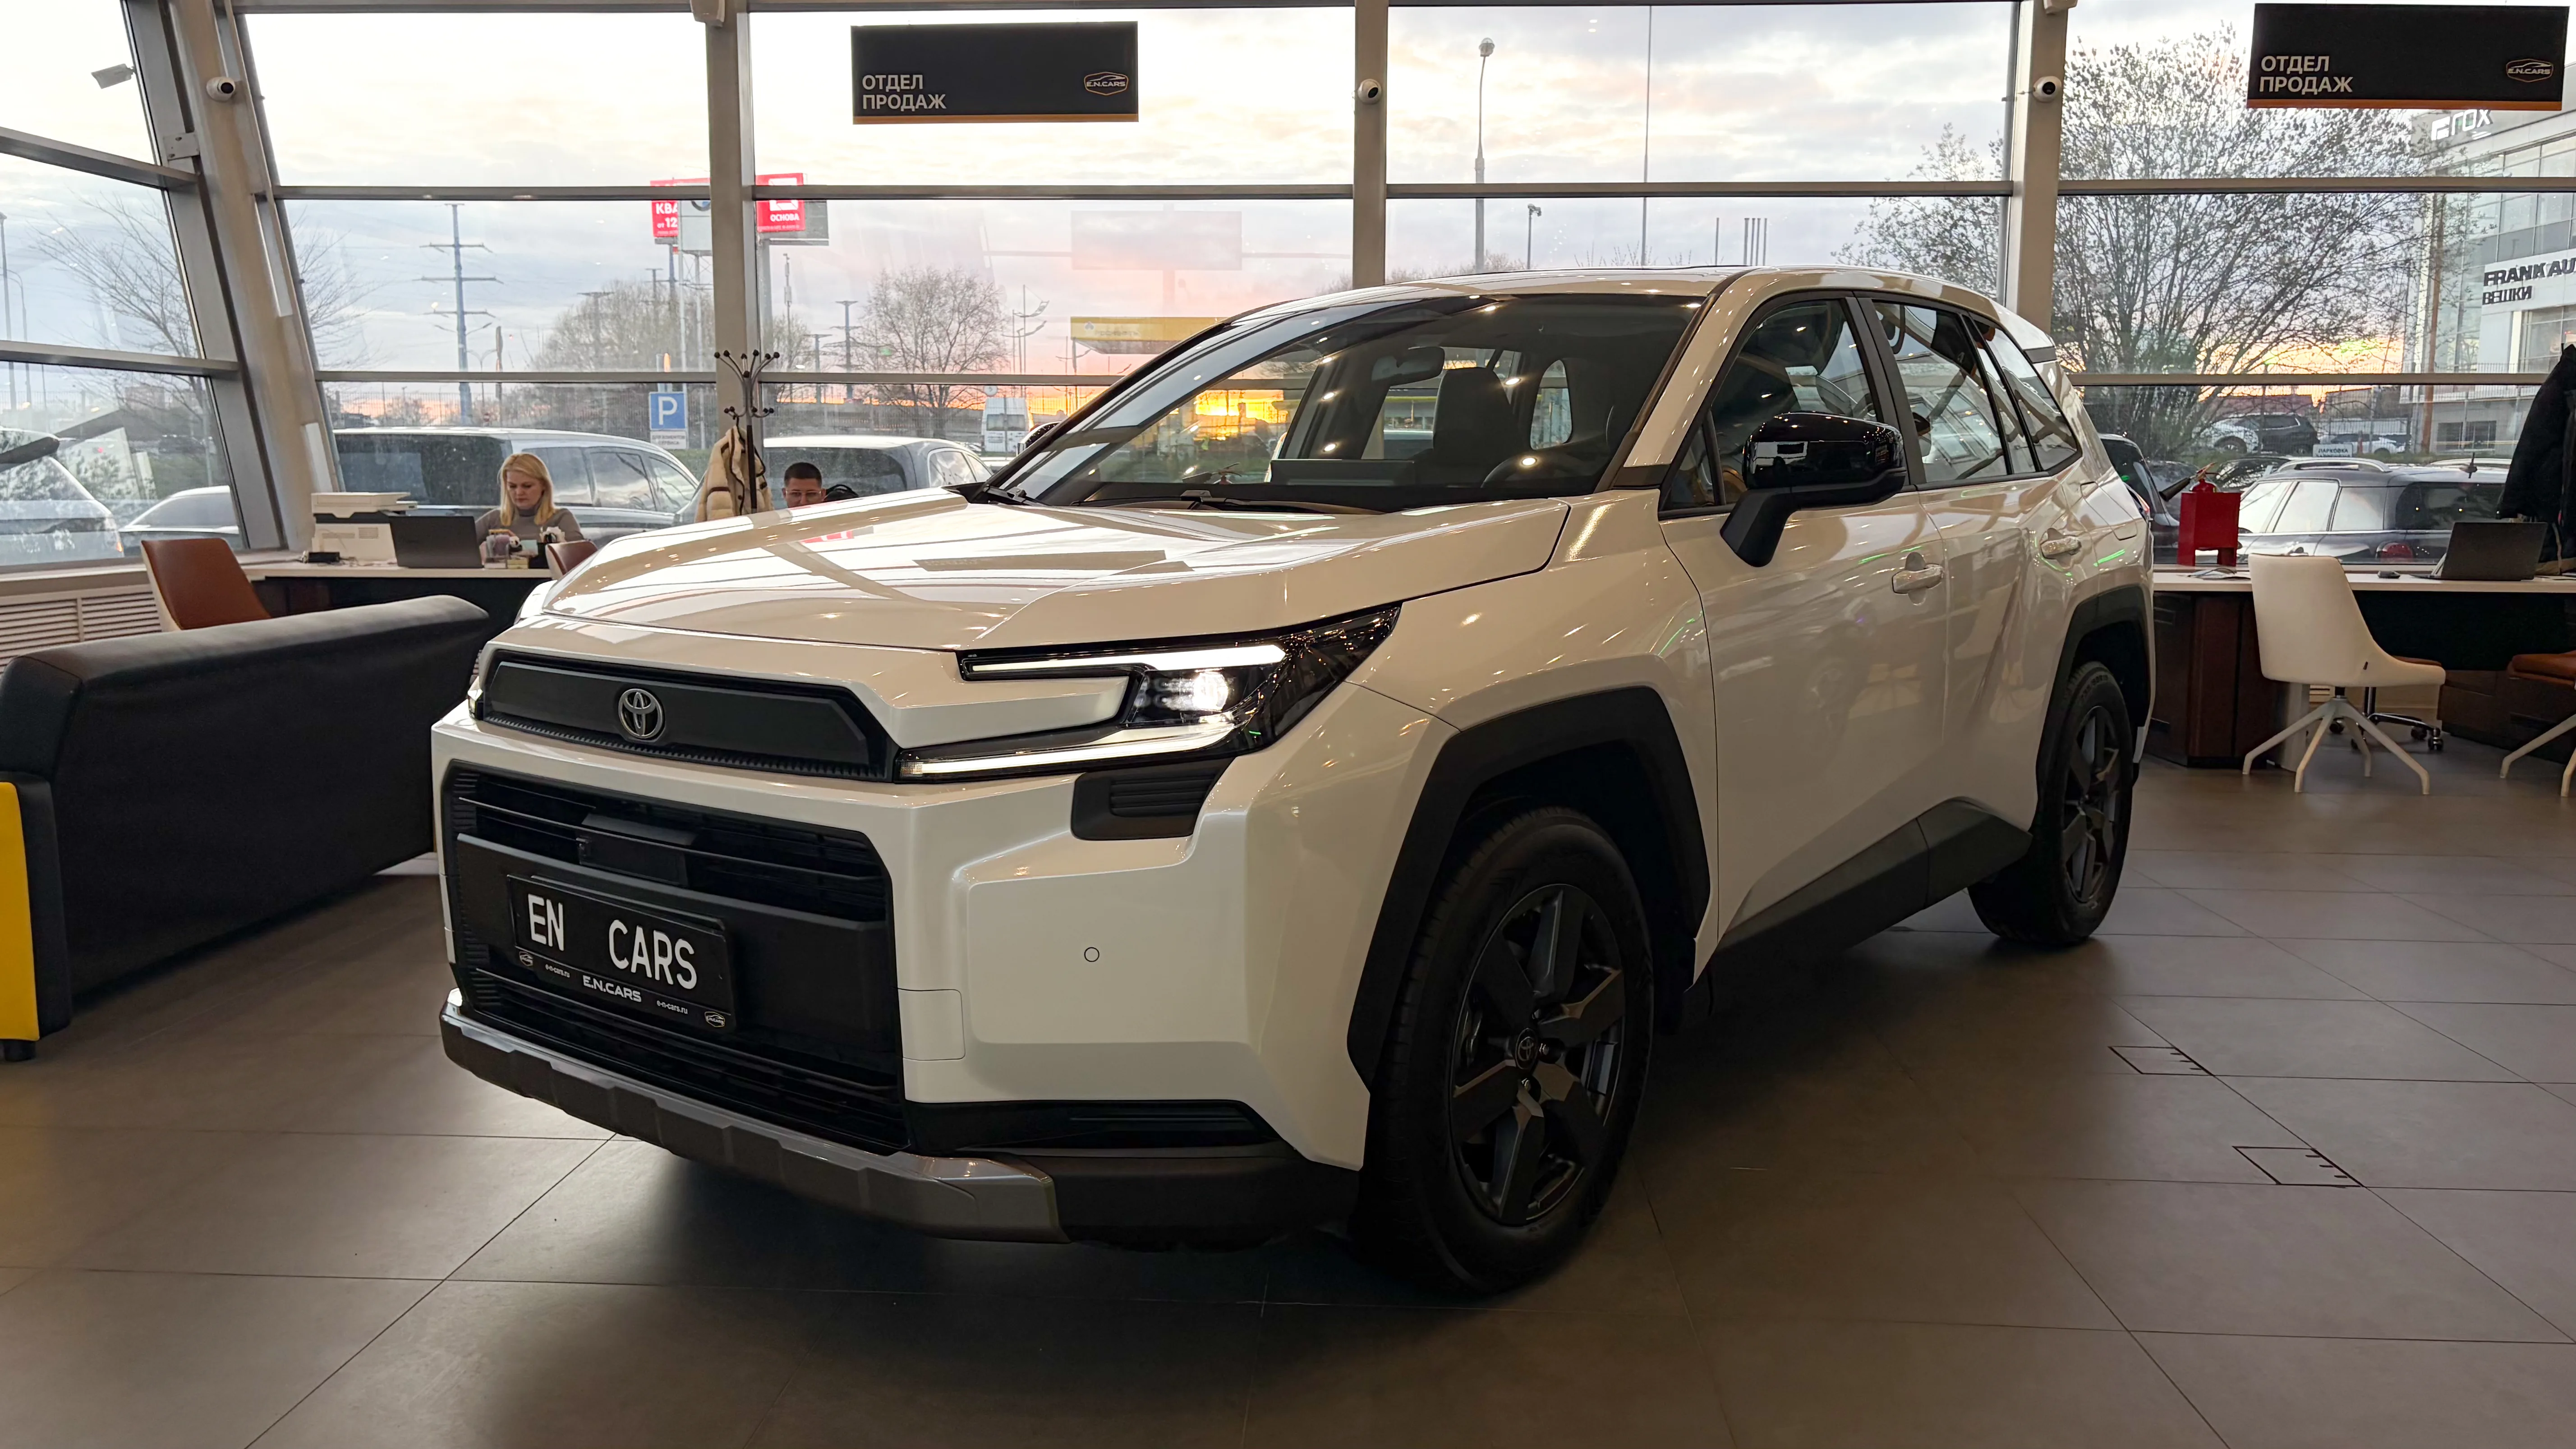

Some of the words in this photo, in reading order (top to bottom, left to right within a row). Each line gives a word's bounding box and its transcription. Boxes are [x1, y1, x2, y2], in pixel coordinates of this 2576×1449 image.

[2261, 55, 2329, 74] ОТДЕЛ
[862, 74, 923, 92] ОТДЕЛ
[2259, 76, 2353, 95] ПРОДАЖ
[863, 94, 947, 111] ПРОДАЖ
[770, 213, 800, 222] ОСНОВА
[2484, 262, 2546, 286] FRANK
[2482, 286, 2532, 305] ВЕШКИ
[658, 396, 677, 425] P
[528, 893, 564, 951] EN
[609, 919, 697, 989] CARS
[583, 975, 642, 1003] E.N.CARS
[657, 1000, 688, 1014] e-n-cars.ru
